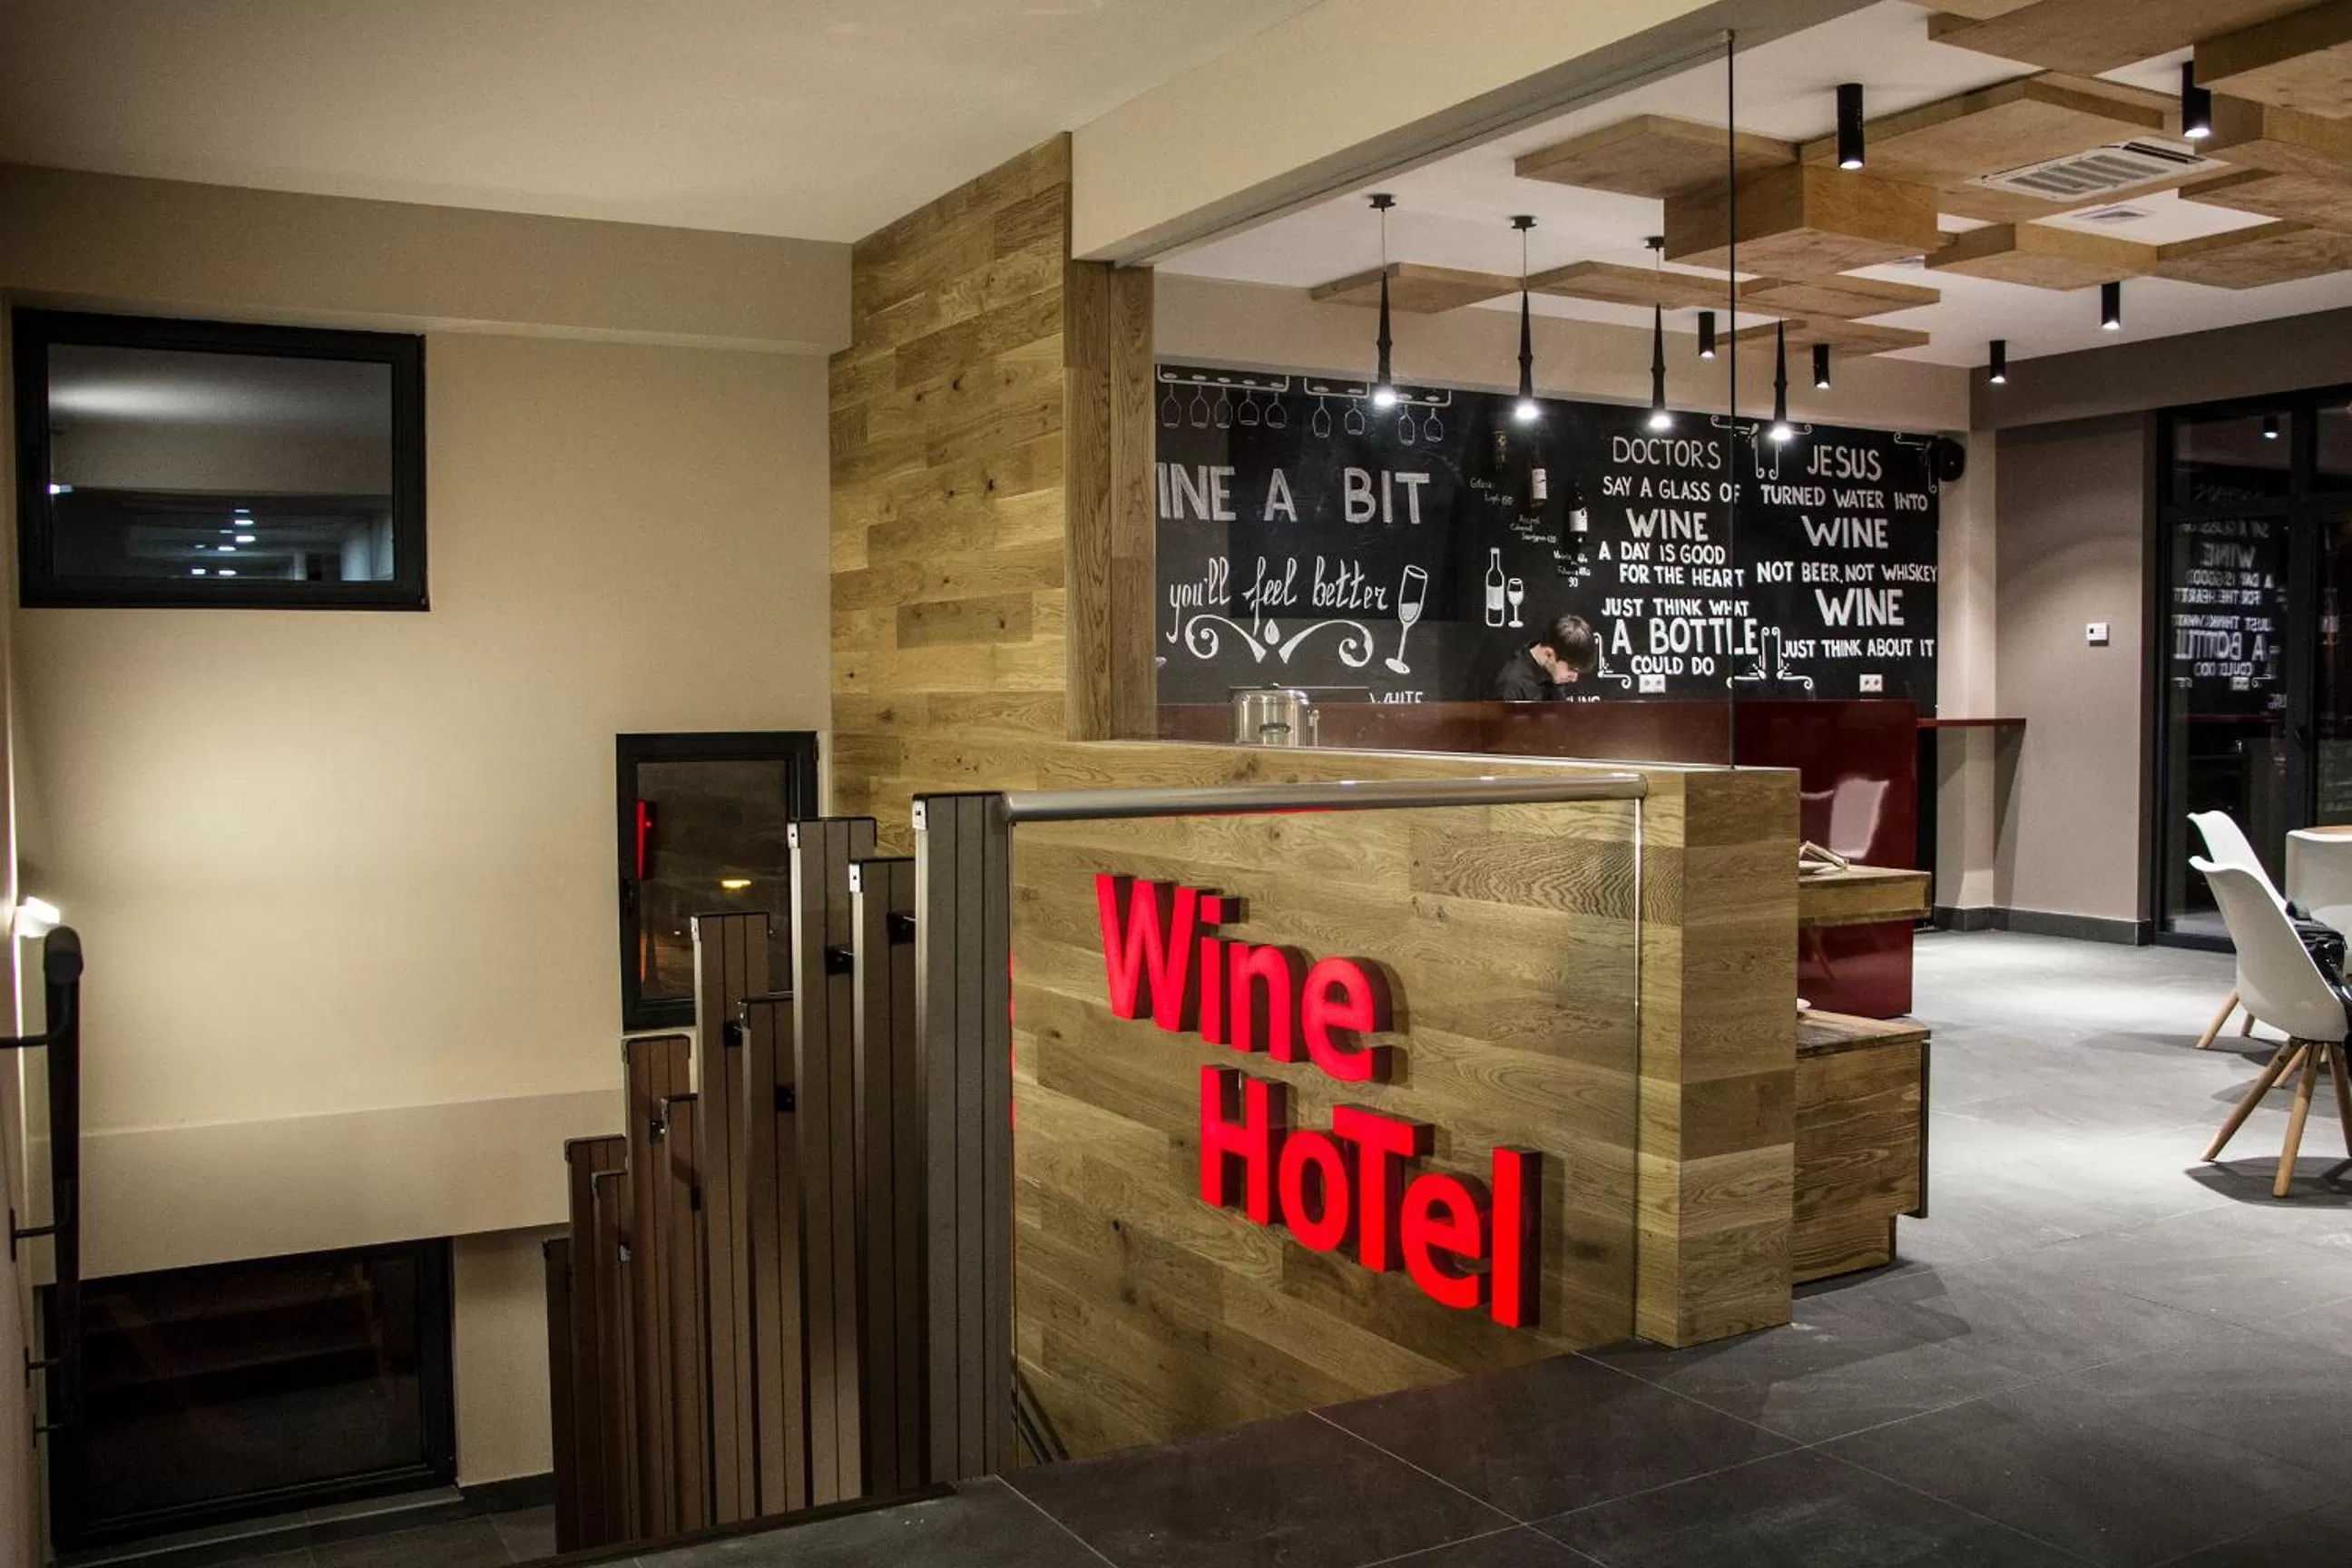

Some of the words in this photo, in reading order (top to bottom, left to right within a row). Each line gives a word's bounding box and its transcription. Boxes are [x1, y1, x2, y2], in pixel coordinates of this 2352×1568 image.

[1613, 436, 1720, 469] DOCTORS
[1808, 445, 1881, 481] JESUS
[1155, 462, 1236, 521] INE
[1264, 469, 1297, 522] A
[1345, 467, 1429, 524] BIT
[1603, 476, 1632, 495] SAY
[1641, 477, 1652, 497] A
[1659, 479, 1710, 502] GLASS
[1720, 483, 1740, 502] OF
[1760, 485, 1825, 505] TURNED
[1833, 489, 1884, 508] WATER
[1895, 492, 1927, 511] INTO
[1626, 508, 1708, 541] WINE
[1801, 515, 1888, 548] WINE
[1599, 541, 1611, 560] A
[1622, 542, 1650, 560] DAY
[1660, 544, 1675, 562] IS
[1681, 544, 1725, 564] GOOD
[1620, 564, 1650, 583] FOR
[1653, 566, 1684, 584] THE
[1692, 568, 1744, 587] HEART
[1757, 562, 1793, 583] NOT
[1846, 564, 1874, 582] NOT
[1881, 564, 1936, 583] WHISKEY
[1166, 557, 1230, 645] you'll
[1240, 556, 1297, 635] feel
[1313, 556, 1387, 610] better
[1602, 598, 1643, 617] JUST
[1653, 598, 1702, 615] THINK
[1709, 600, 1749, 616] WHAT
[1815, 588, 1904, 626] WINE
[1612, 619, 1632, 654] A
[1650, 617, 1758, 654] BOTTLE
[1781, 640, 1816, 658] JUST
[1821, 640, 1862, 657] THINK
[1867, 639, 1913, 657] ABOUT
[1920, 640, 1934, 657] IT
[1632, 655, 1683, 675] COULD
[1691, 657, 1714, 675] DO
[1095, 873, 1383, 1083] Wine
[1200, 1064, 1530, 1328] HoTel
